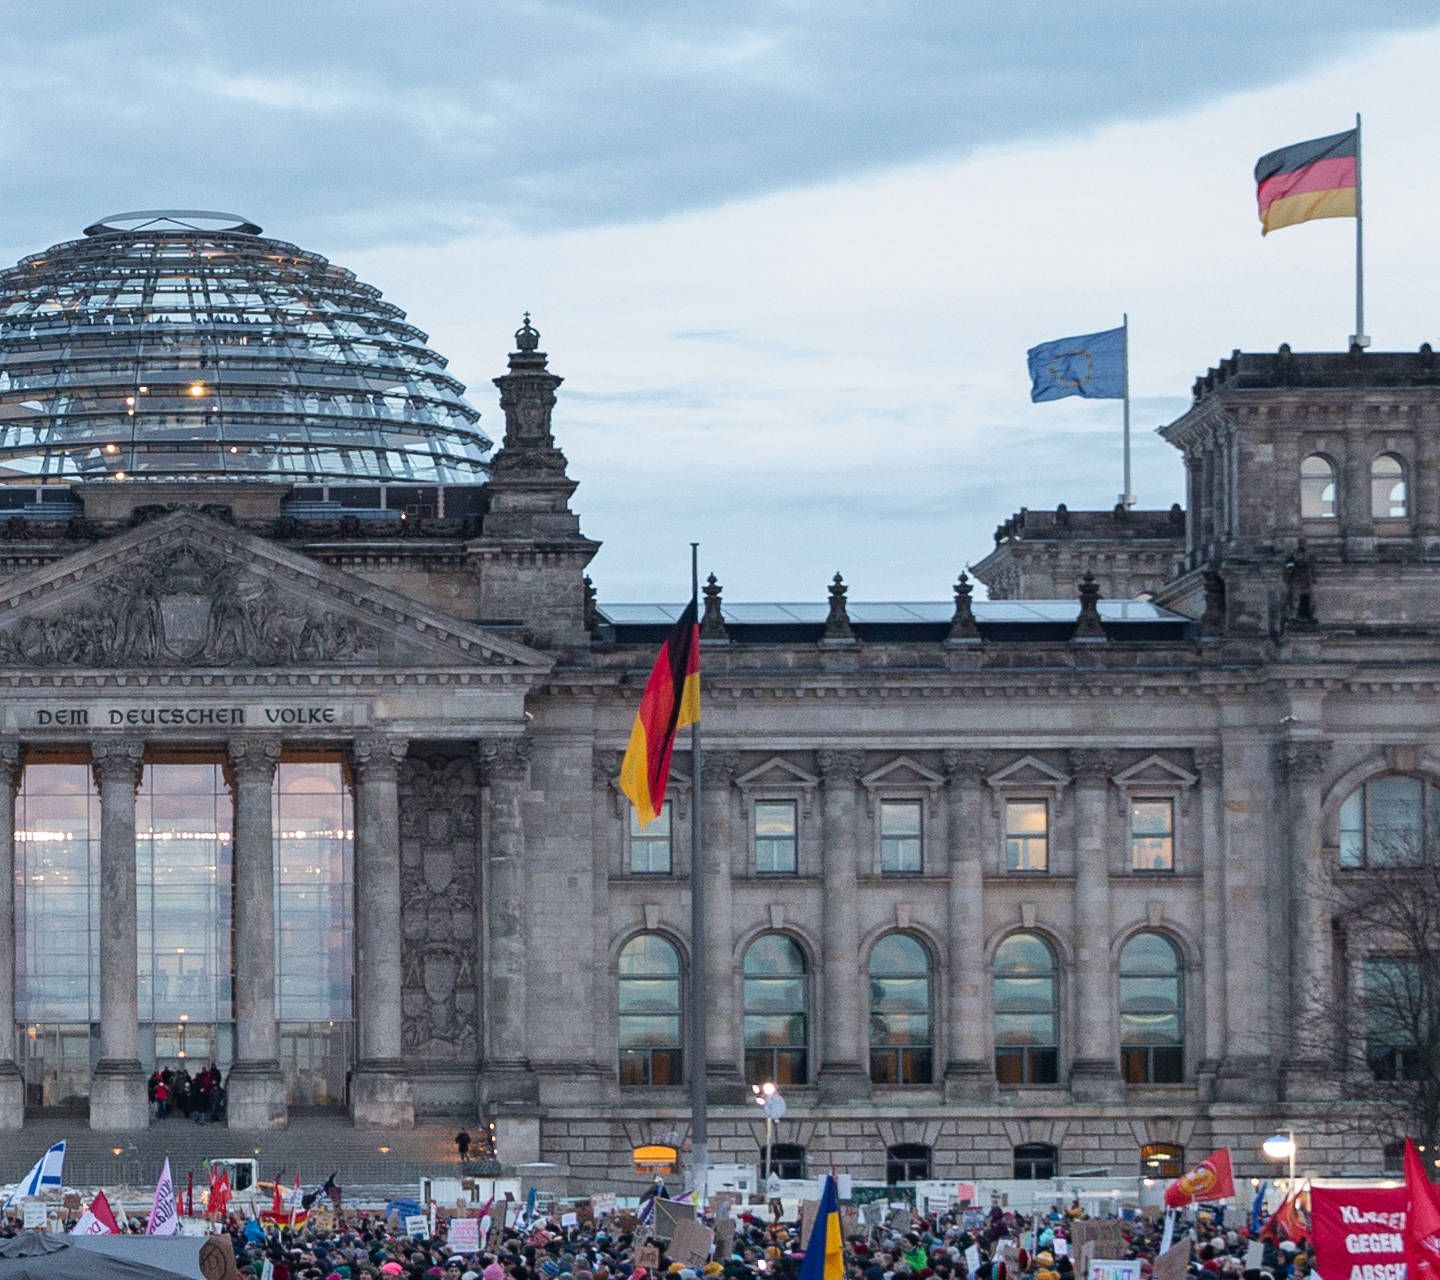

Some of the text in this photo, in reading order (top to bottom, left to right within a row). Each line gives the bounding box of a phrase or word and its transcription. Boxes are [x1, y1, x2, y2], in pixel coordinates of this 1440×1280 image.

[38, 707, 336, 724] DEM DEUTSCHEN VOLKE
[1345, 1233, 1403, 1254] GEGEN
